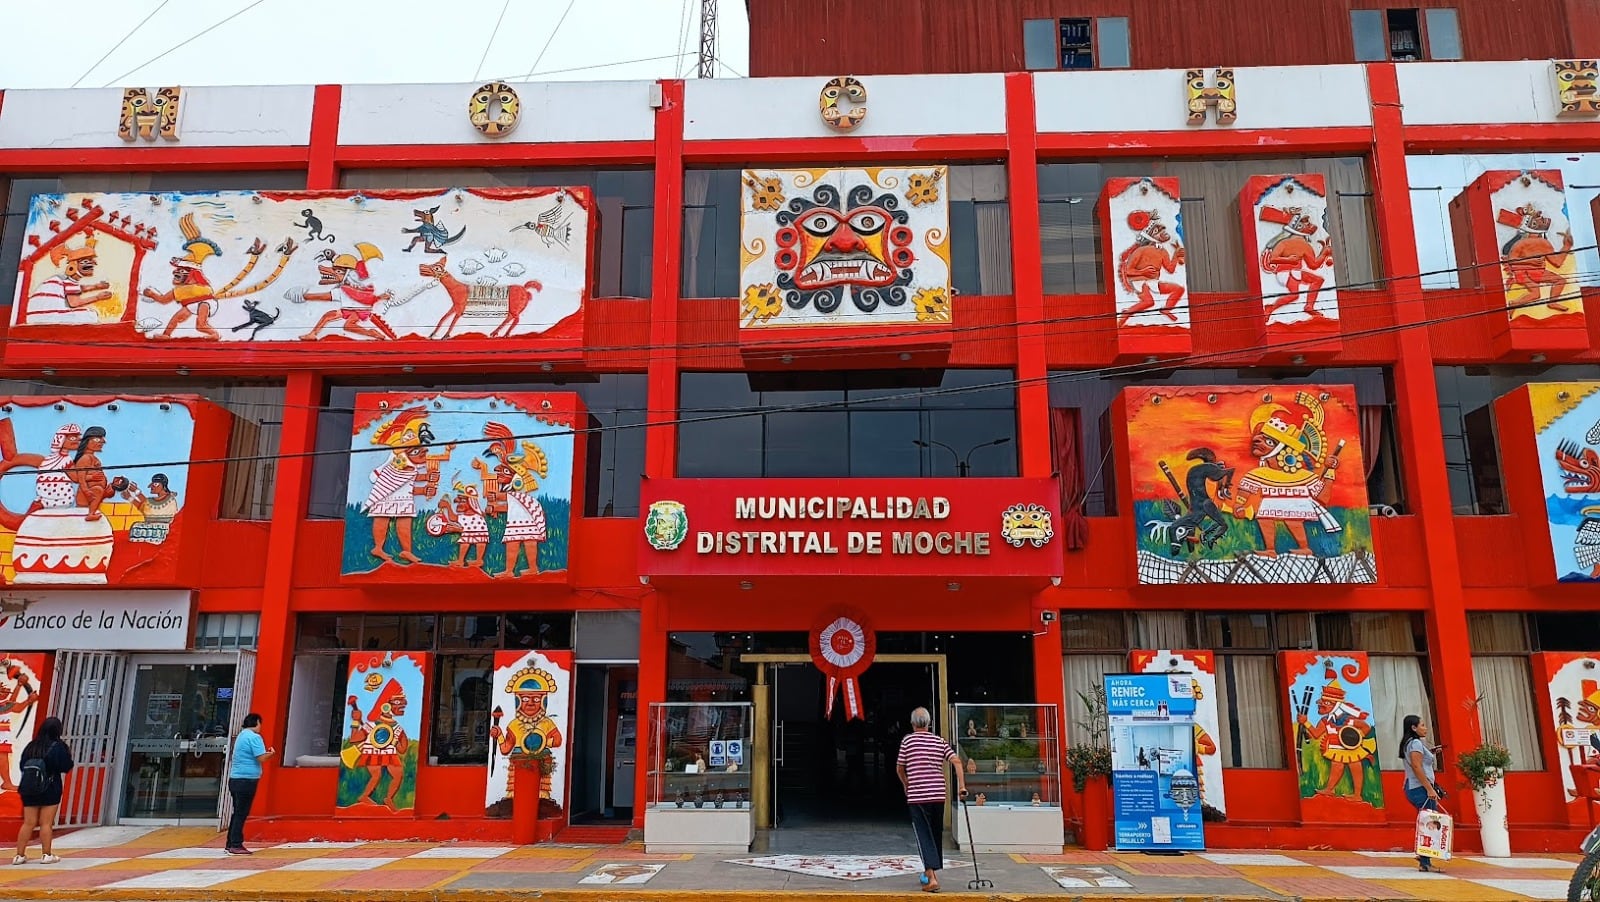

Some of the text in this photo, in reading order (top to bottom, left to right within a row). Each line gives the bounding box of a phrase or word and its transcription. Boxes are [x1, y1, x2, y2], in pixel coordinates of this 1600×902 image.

[735, 496, 951, 519] MUNICIPALIDAD
[697, 531, 991, 556] DISTRITAL DE MOCHE
[13, 609, 183, 630] Banco de la Nación
[1111, 687, 1146, 698] RENIEC
[1112, 698, 1129, 707] MÁS
[1440, 825, 1448, 850] HUGGIES
